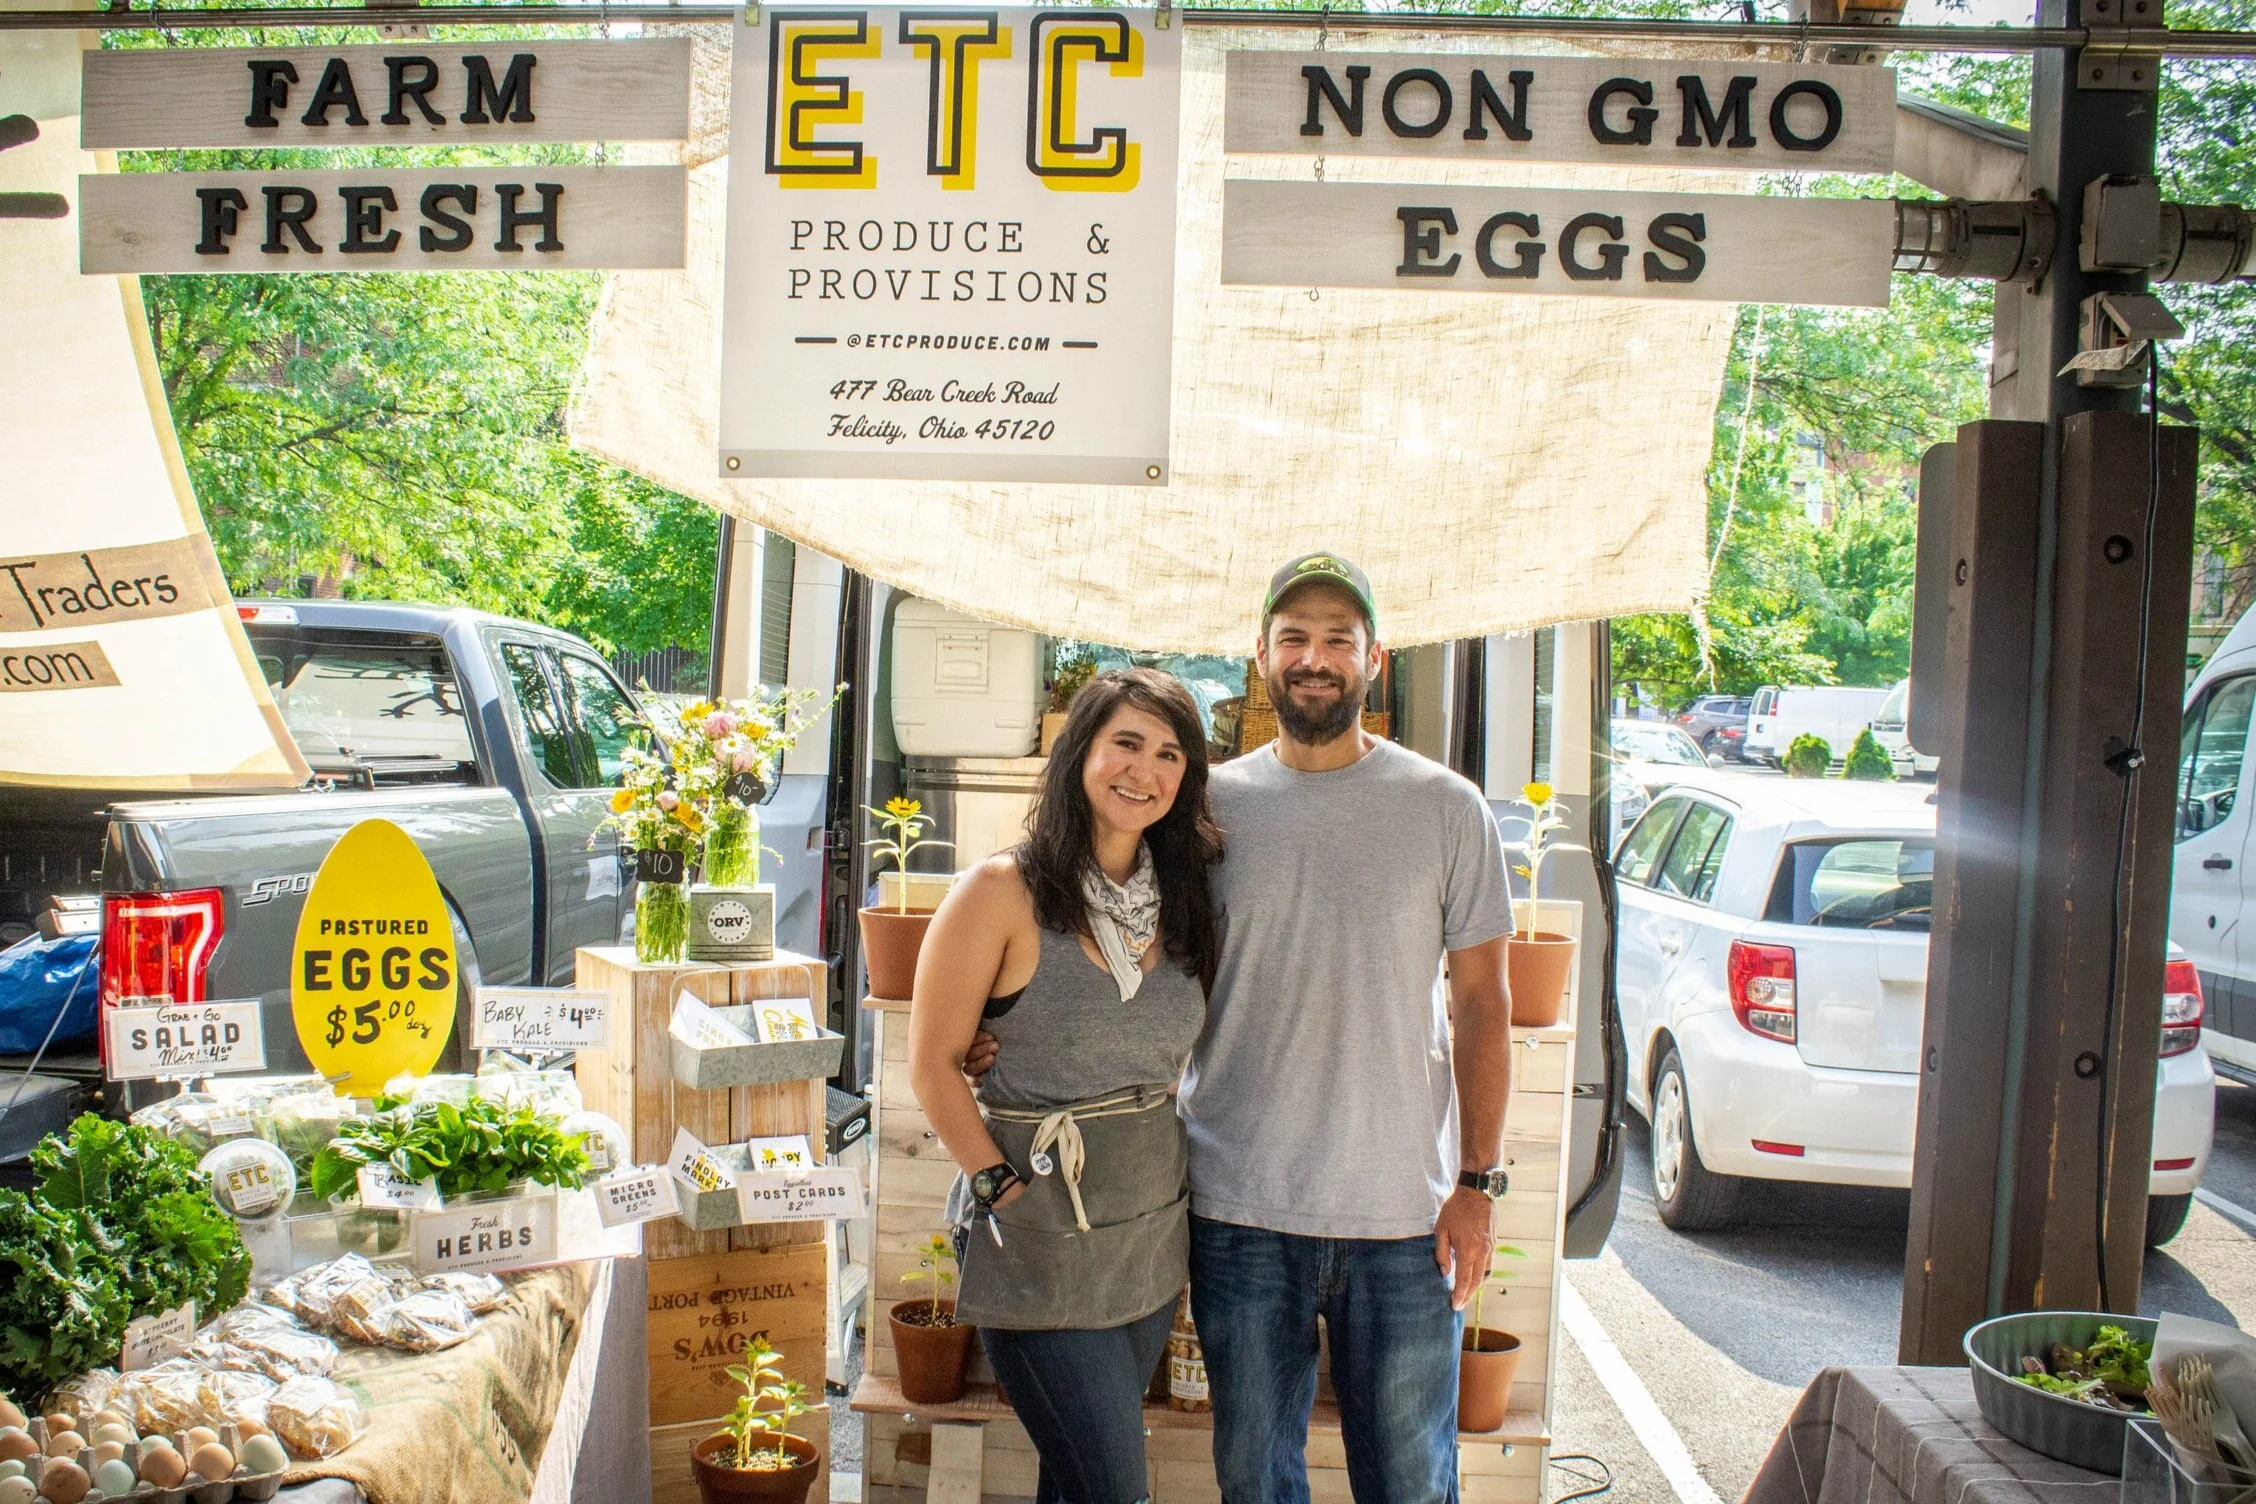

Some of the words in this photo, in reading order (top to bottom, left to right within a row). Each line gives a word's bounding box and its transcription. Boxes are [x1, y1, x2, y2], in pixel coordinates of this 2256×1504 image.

[244, 53, 537, 127] FARM
[765, 11, 1144, 192] ETC
[1300, 64, 1533, 141] NON
[1587, 75, 1842, 151] GMO
[194, 182, 565, 255] FRESH
[789, 219, 1023, 253] PRODUCE
[1086, 222, 1110, 255] &
[1396, 206, 1707, 283] EGGS
[787, 268, 1108, 305] PROVISIONS
[846, 333, 1051, 352] @ETCPRODUCE.COM
[829, 379, 878, 400] 477
[882, 378, 935, 402] Bear
[940, 379, 997, 404] Creek
[1000, 380, 1061, 405] Road
[826, 413, 908, 445] Felicity,
[918, 415, 968, 439] Ohio
[974, 418, 1056, 441] 45120
[0, 553, 179, 628] Traders
[320, 919, 429, 936] PASTURED
[714, 917, 744, 927] ORV
[304, 946, 451, 992] EGGS
[483, 1000, 526, 1024] BABY
[131, 1022, 241, 1051] SALAD
[513, 1020, 553, 1040] KALE
[226, 1163, 270, 1192] ETC
[684, 1153, 731, 1188] FINDLAY
[610, 1179, 654, 1196] MICRO
[612, 1188, 657, 1205] GREENS
[753, 1189, 790, 1200] POST
[798, 1186, 846, 1198] CARDS
[470, 1215, 499, 1230] Fresh
[436, 1226, 533, 1259] HERBS
[649, 1292, 700, 1312] PORT
[1173, 1361, 1207, 1383] ETC
